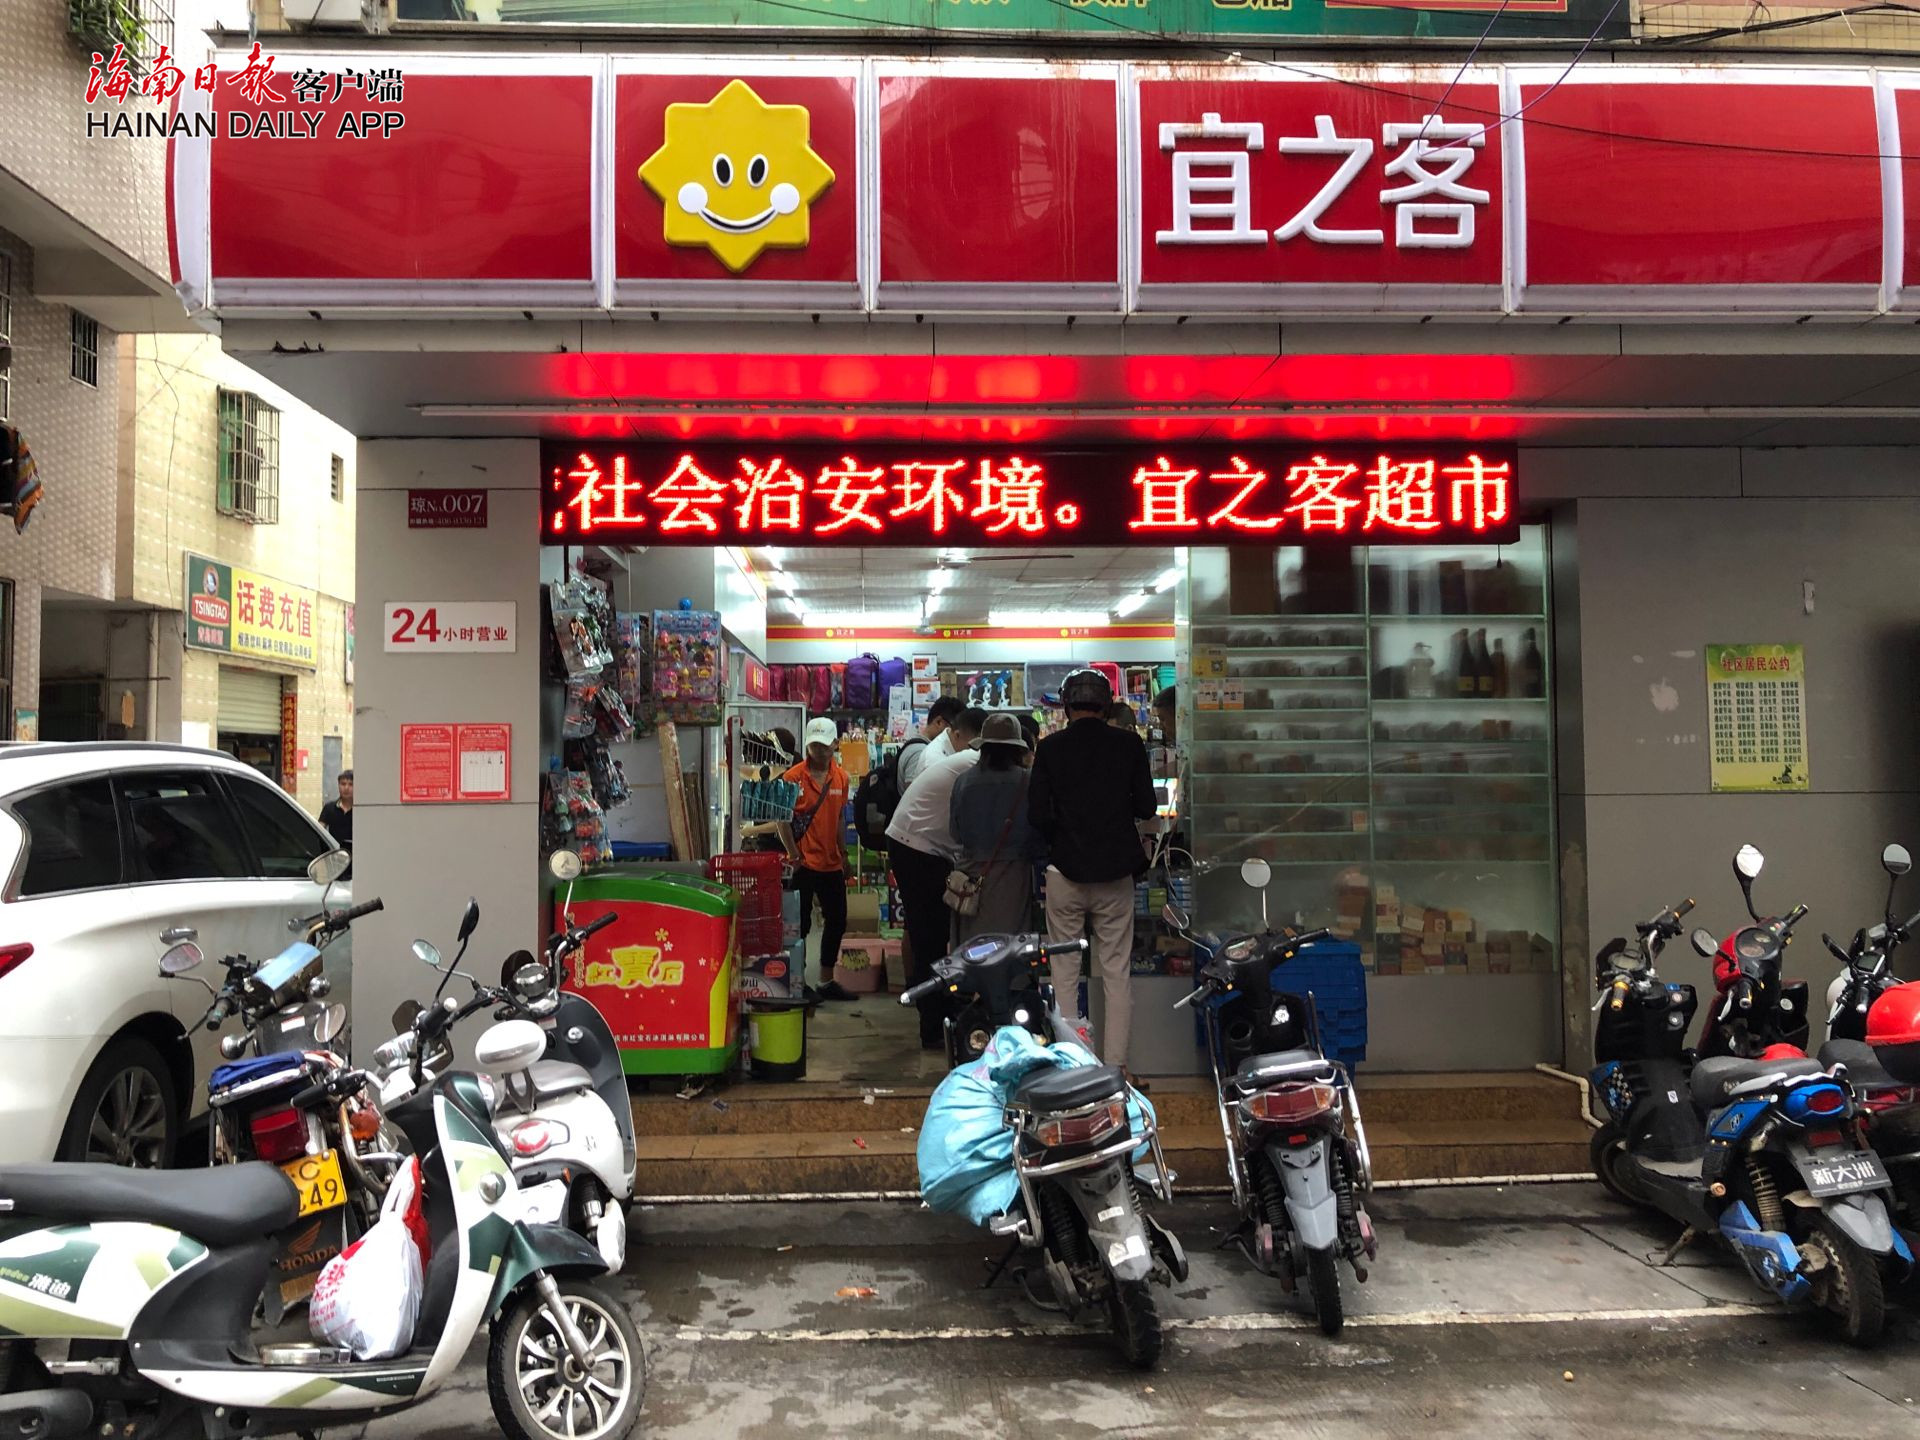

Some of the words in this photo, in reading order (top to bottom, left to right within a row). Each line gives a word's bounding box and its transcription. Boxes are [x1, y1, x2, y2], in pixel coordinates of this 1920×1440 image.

[1155, 111, 1491, 249] 宜之客
[194, 599, 228, 620] TSINGTAO
[236, 579, 312, 638] 话费充值
[1723, 655, 1790, 672] 社区居民公约
[1811, 1160, 1876, 1186] 新大洲
[279, 1245, 337, 1271] HONDA
